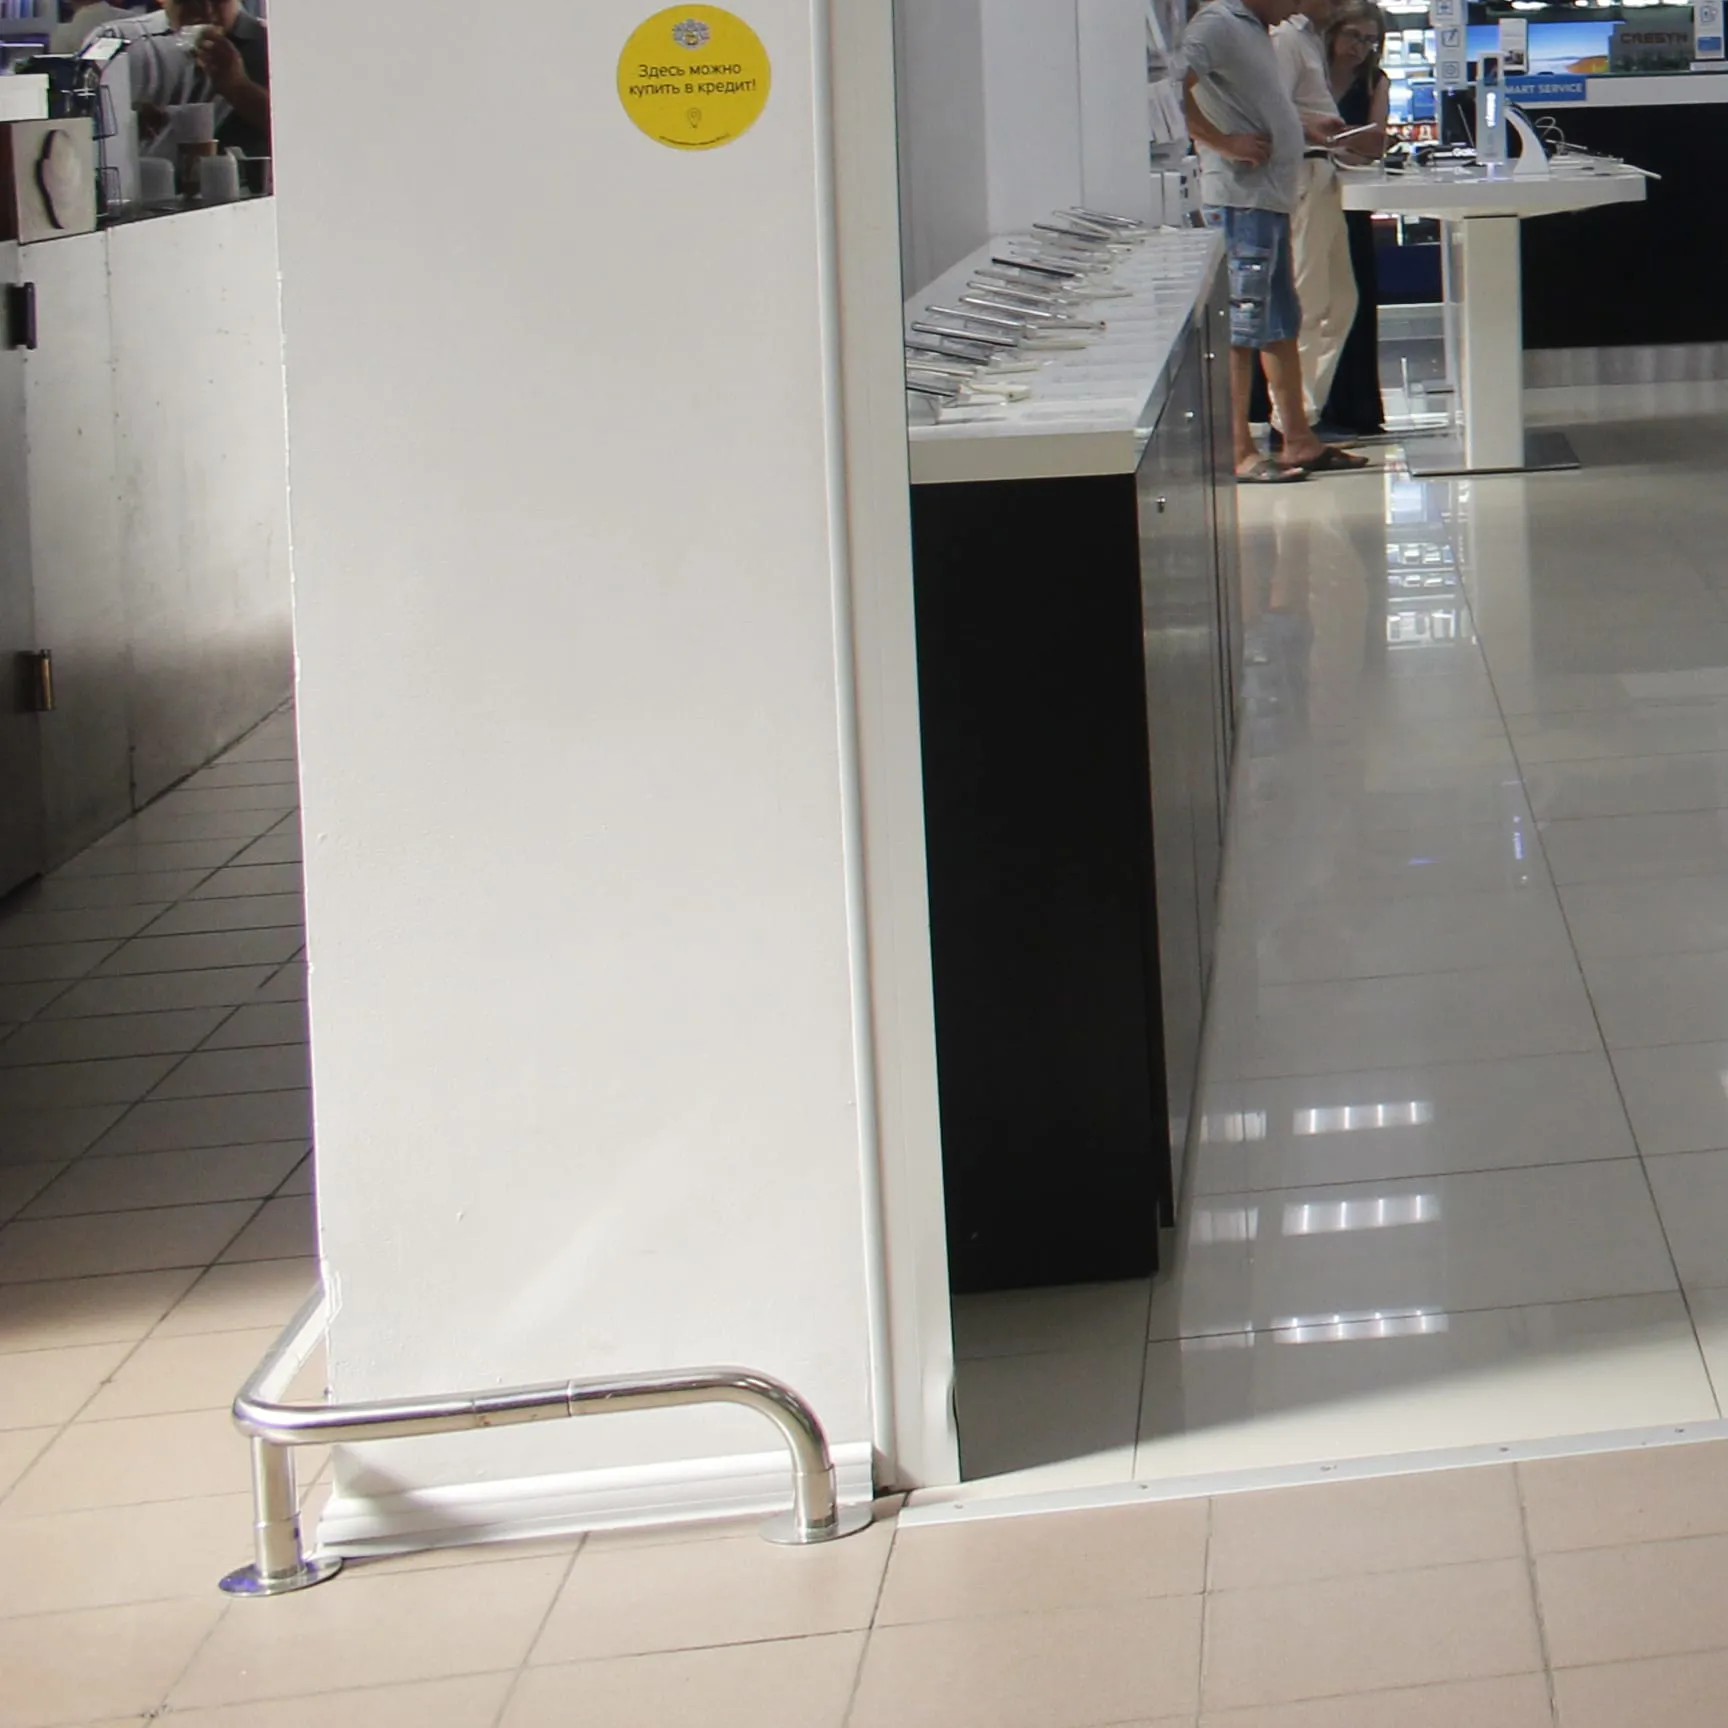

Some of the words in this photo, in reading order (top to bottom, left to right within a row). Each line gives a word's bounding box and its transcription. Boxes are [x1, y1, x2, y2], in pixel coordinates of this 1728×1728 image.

[638, 64, 686, 79] Здесь
[689, 63, 741, 76] можно
[629, 83, 681, 99] купить
[685, 84, 694, 95] в
[698, 79, 756, 95] кредит!
[1538, 82, 1583, 94] SERVICE
